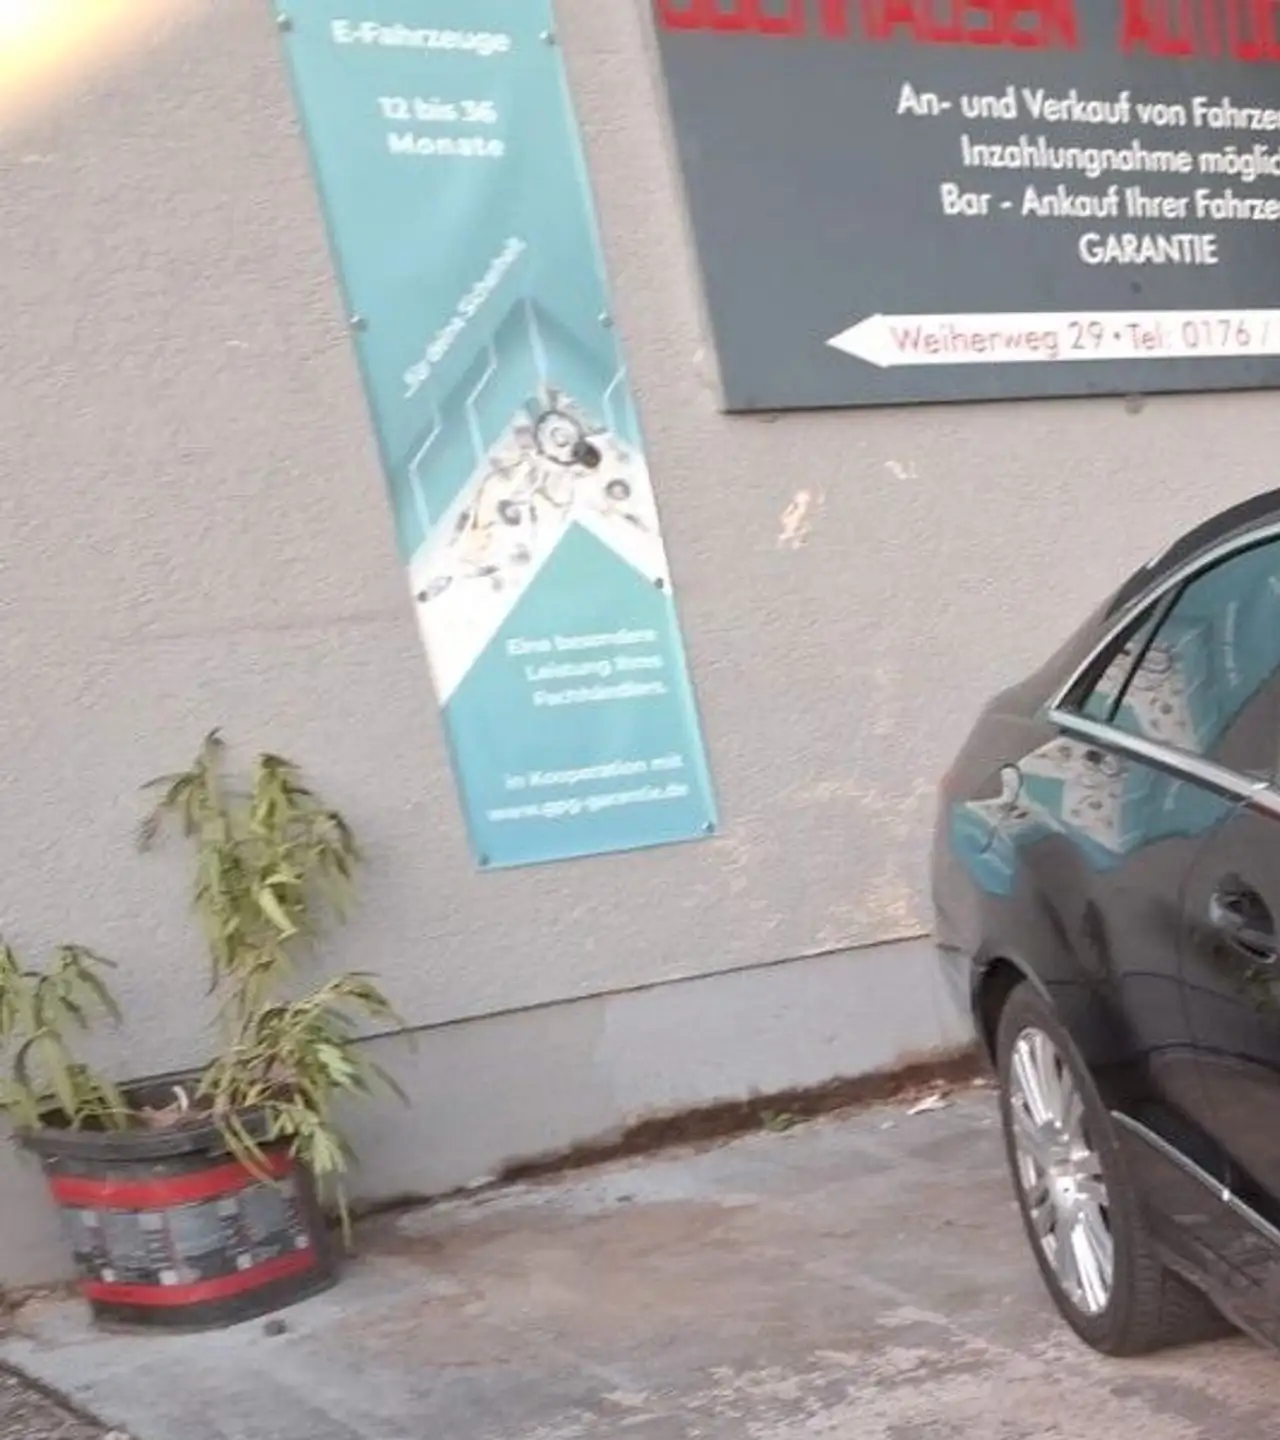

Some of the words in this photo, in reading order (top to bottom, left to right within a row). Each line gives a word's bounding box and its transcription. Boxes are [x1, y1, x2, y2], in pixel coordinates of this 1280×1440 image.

[329, 19, 512, 55] E-Fahrzeuge
[377, 96, 410, 120] 12
[415, 96, 457, 121] bis
[459, 99, 498, 125] 36
[897, 81, 952, 116] An-
[960, 84, 1018, 119] und
[1021, 87, 1131, 124] Verkauf
[1135, 102, 1187, 127] von
[385, 131, 505, 157] Monate
[960, 133, 1194, 178] Inzahlungnahme
[940, 182, 992, 215] Bar
[1021, 183, 1119, 217] Ankauf
[1125, 186, 1189, 218] Ihrer
[1078, 232, 1219, 265] GARANTIE
[889, 323, 1060, 359] Weiherweg
[1067, 320, 1104, 350] 29
[1182, 318, 1252, 349] 0176
